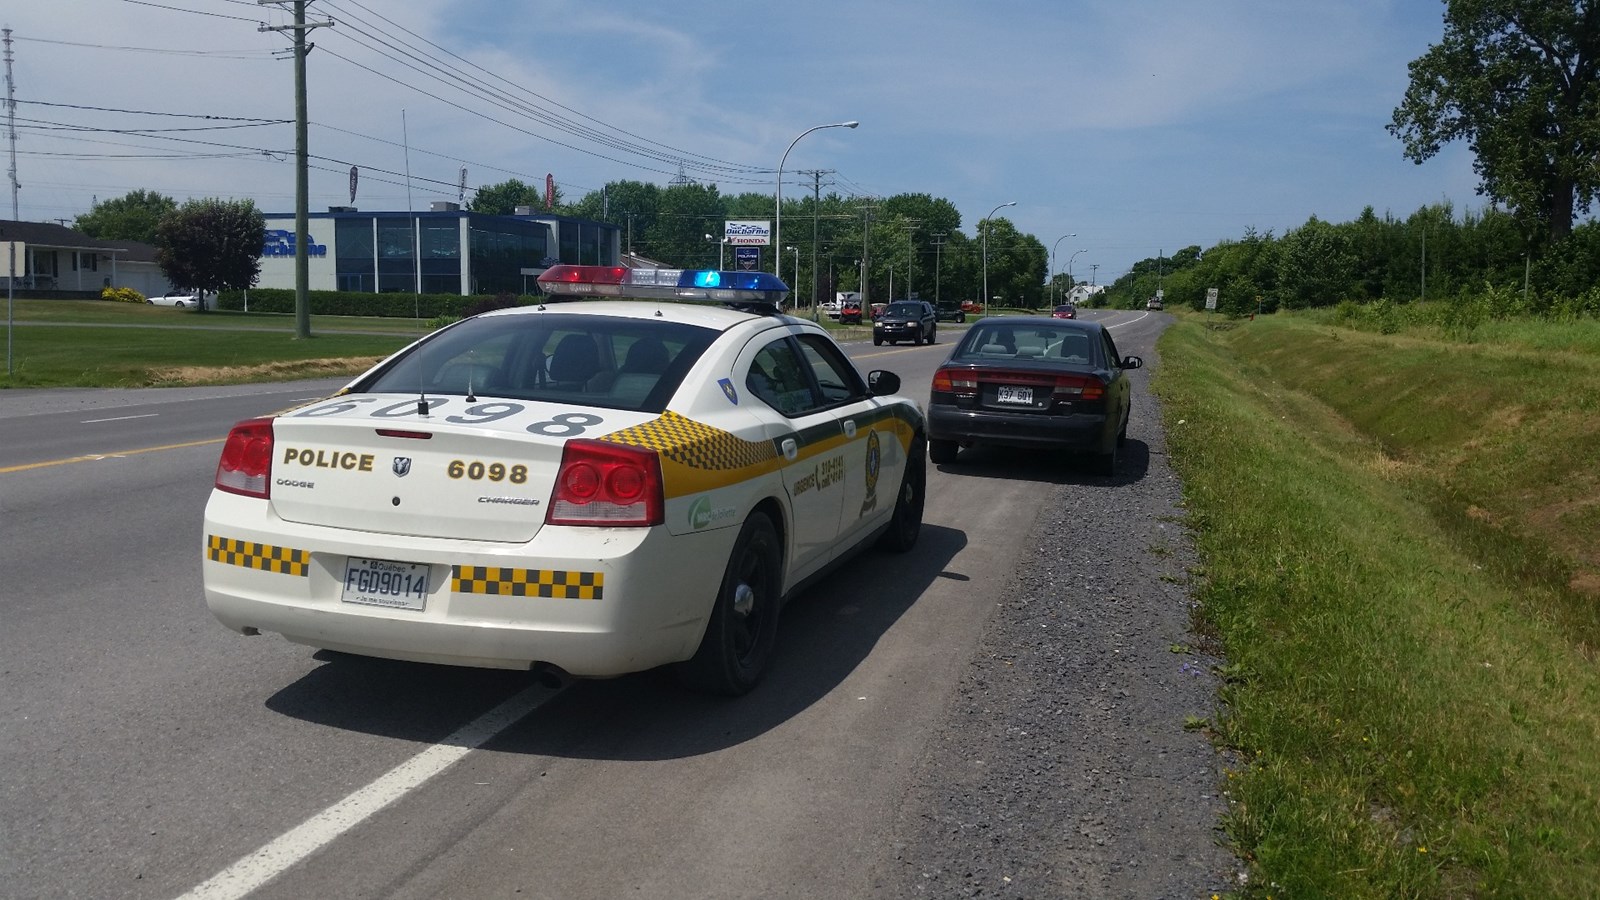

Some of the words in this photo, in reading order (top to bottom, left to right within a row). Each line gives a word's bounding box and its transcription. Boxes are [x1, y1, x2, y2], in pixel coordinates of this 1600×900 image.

[998, 389, 1014, 400] K37
[294, 398, 604, 437] 6098
[283, 447, 375, 472] POLICE
[446, 459, 529, 485] 6098
[276, 478, 315, 490] DODGE
[477, 496, 540, 507] CHARGER
[377, 562, 407, 573] Québec
[346, 568, 425, 599] FGD9014
